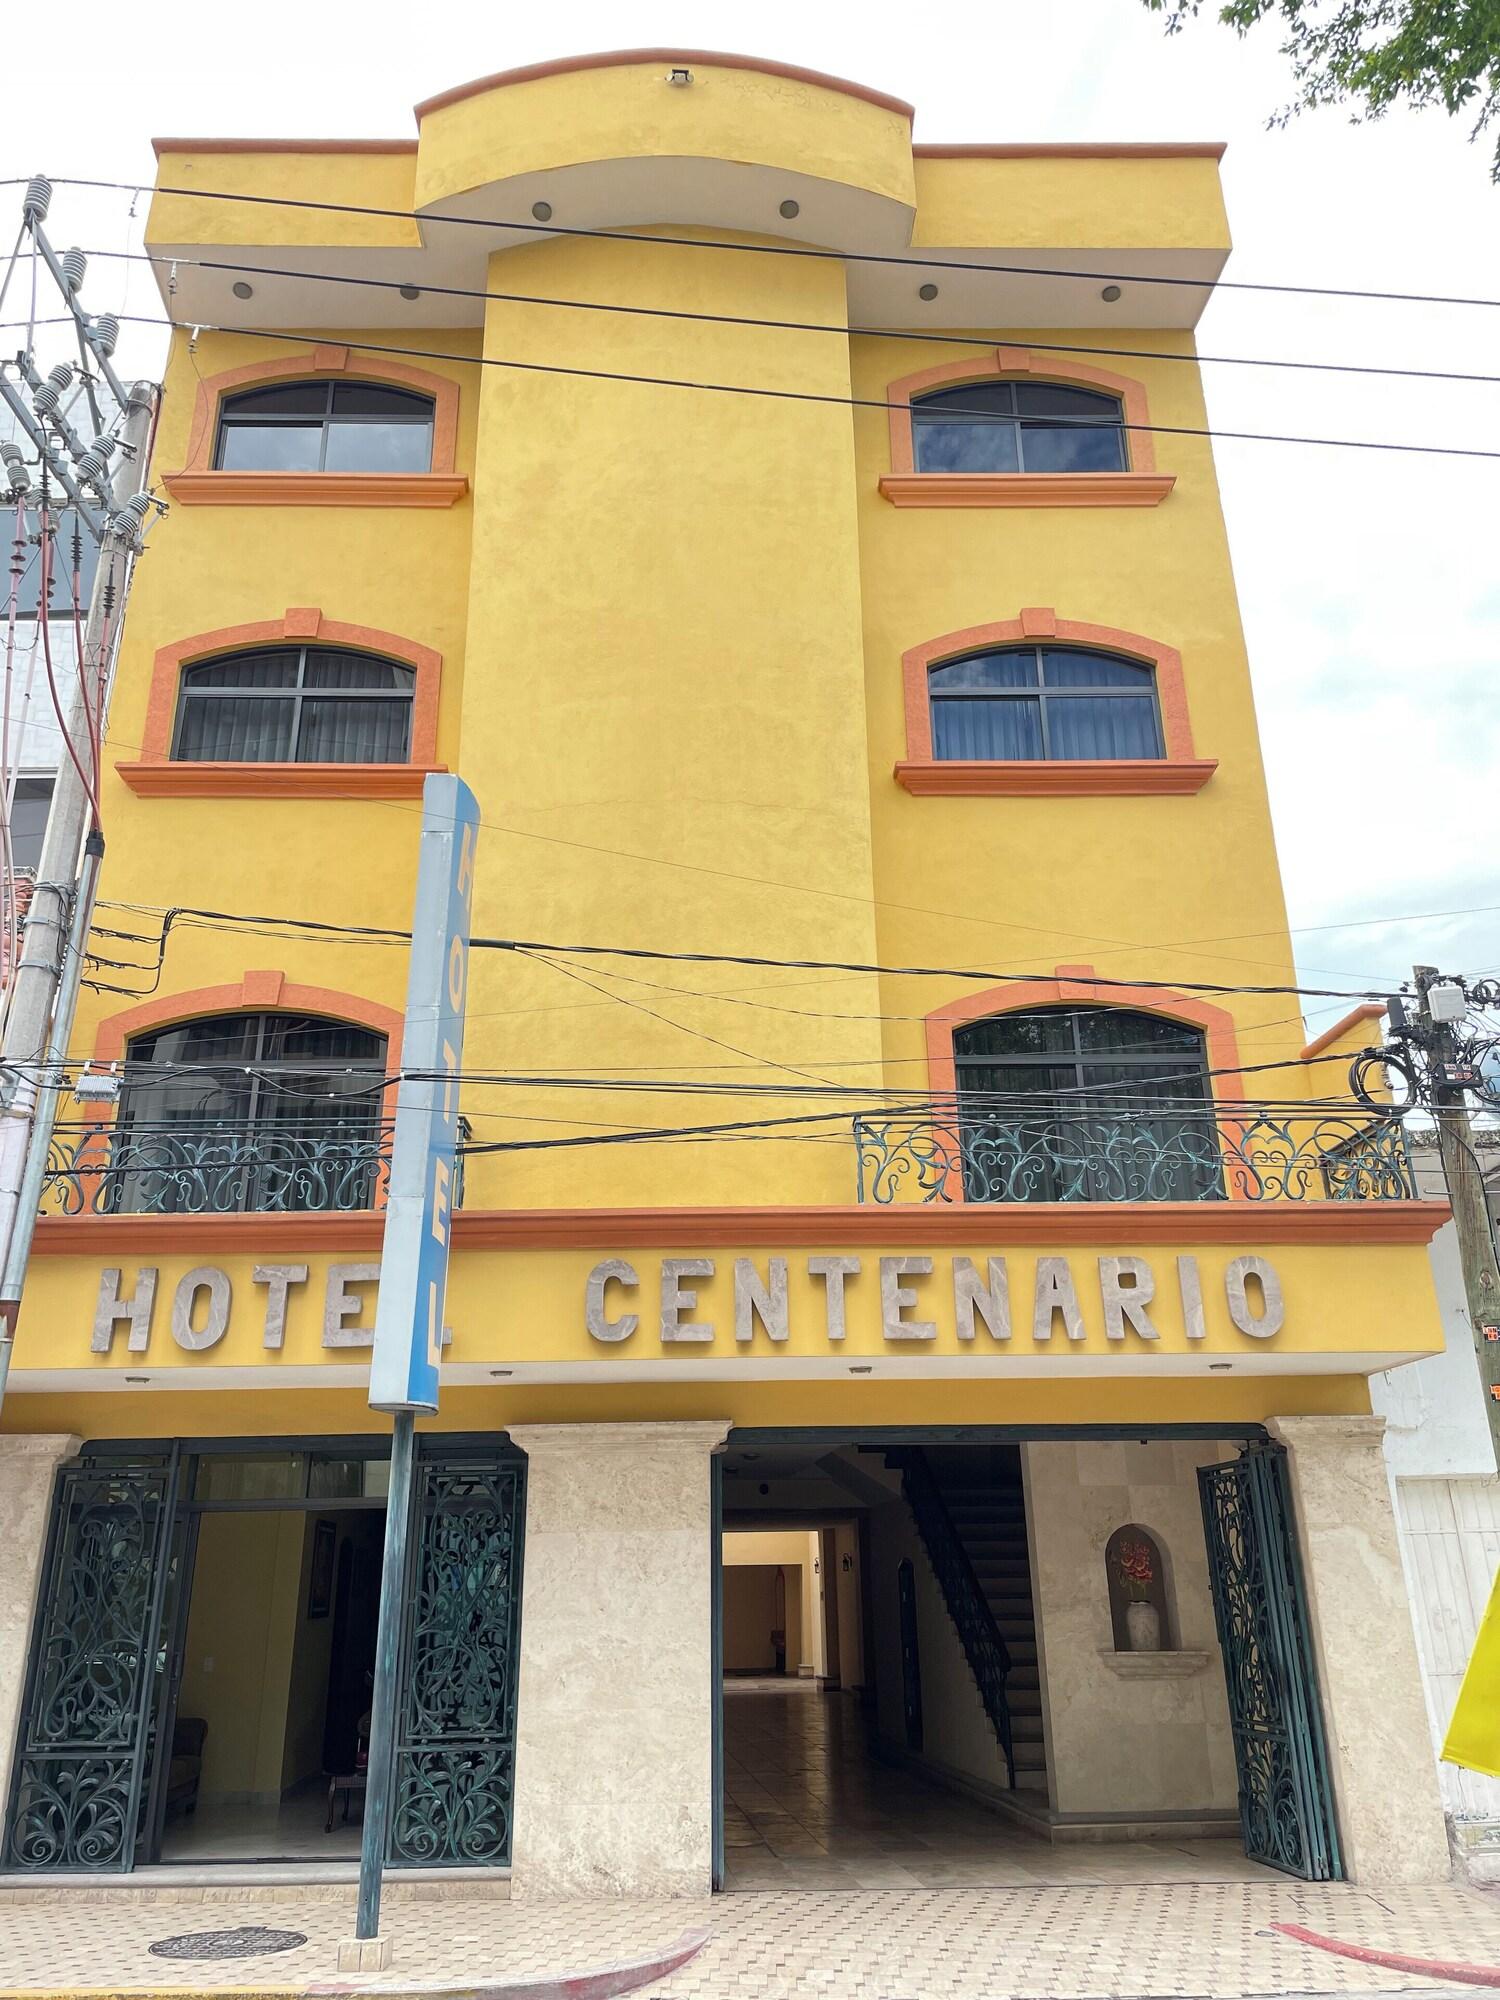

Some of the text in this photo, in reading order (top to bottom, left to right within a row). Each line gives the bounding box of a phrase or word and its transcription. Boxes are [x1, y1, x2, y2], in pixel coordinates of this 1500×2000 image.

[427, 822, 473, 1370] HOTEL
[91, 1255, 1287, 1353] HOTE CENTENARIO
